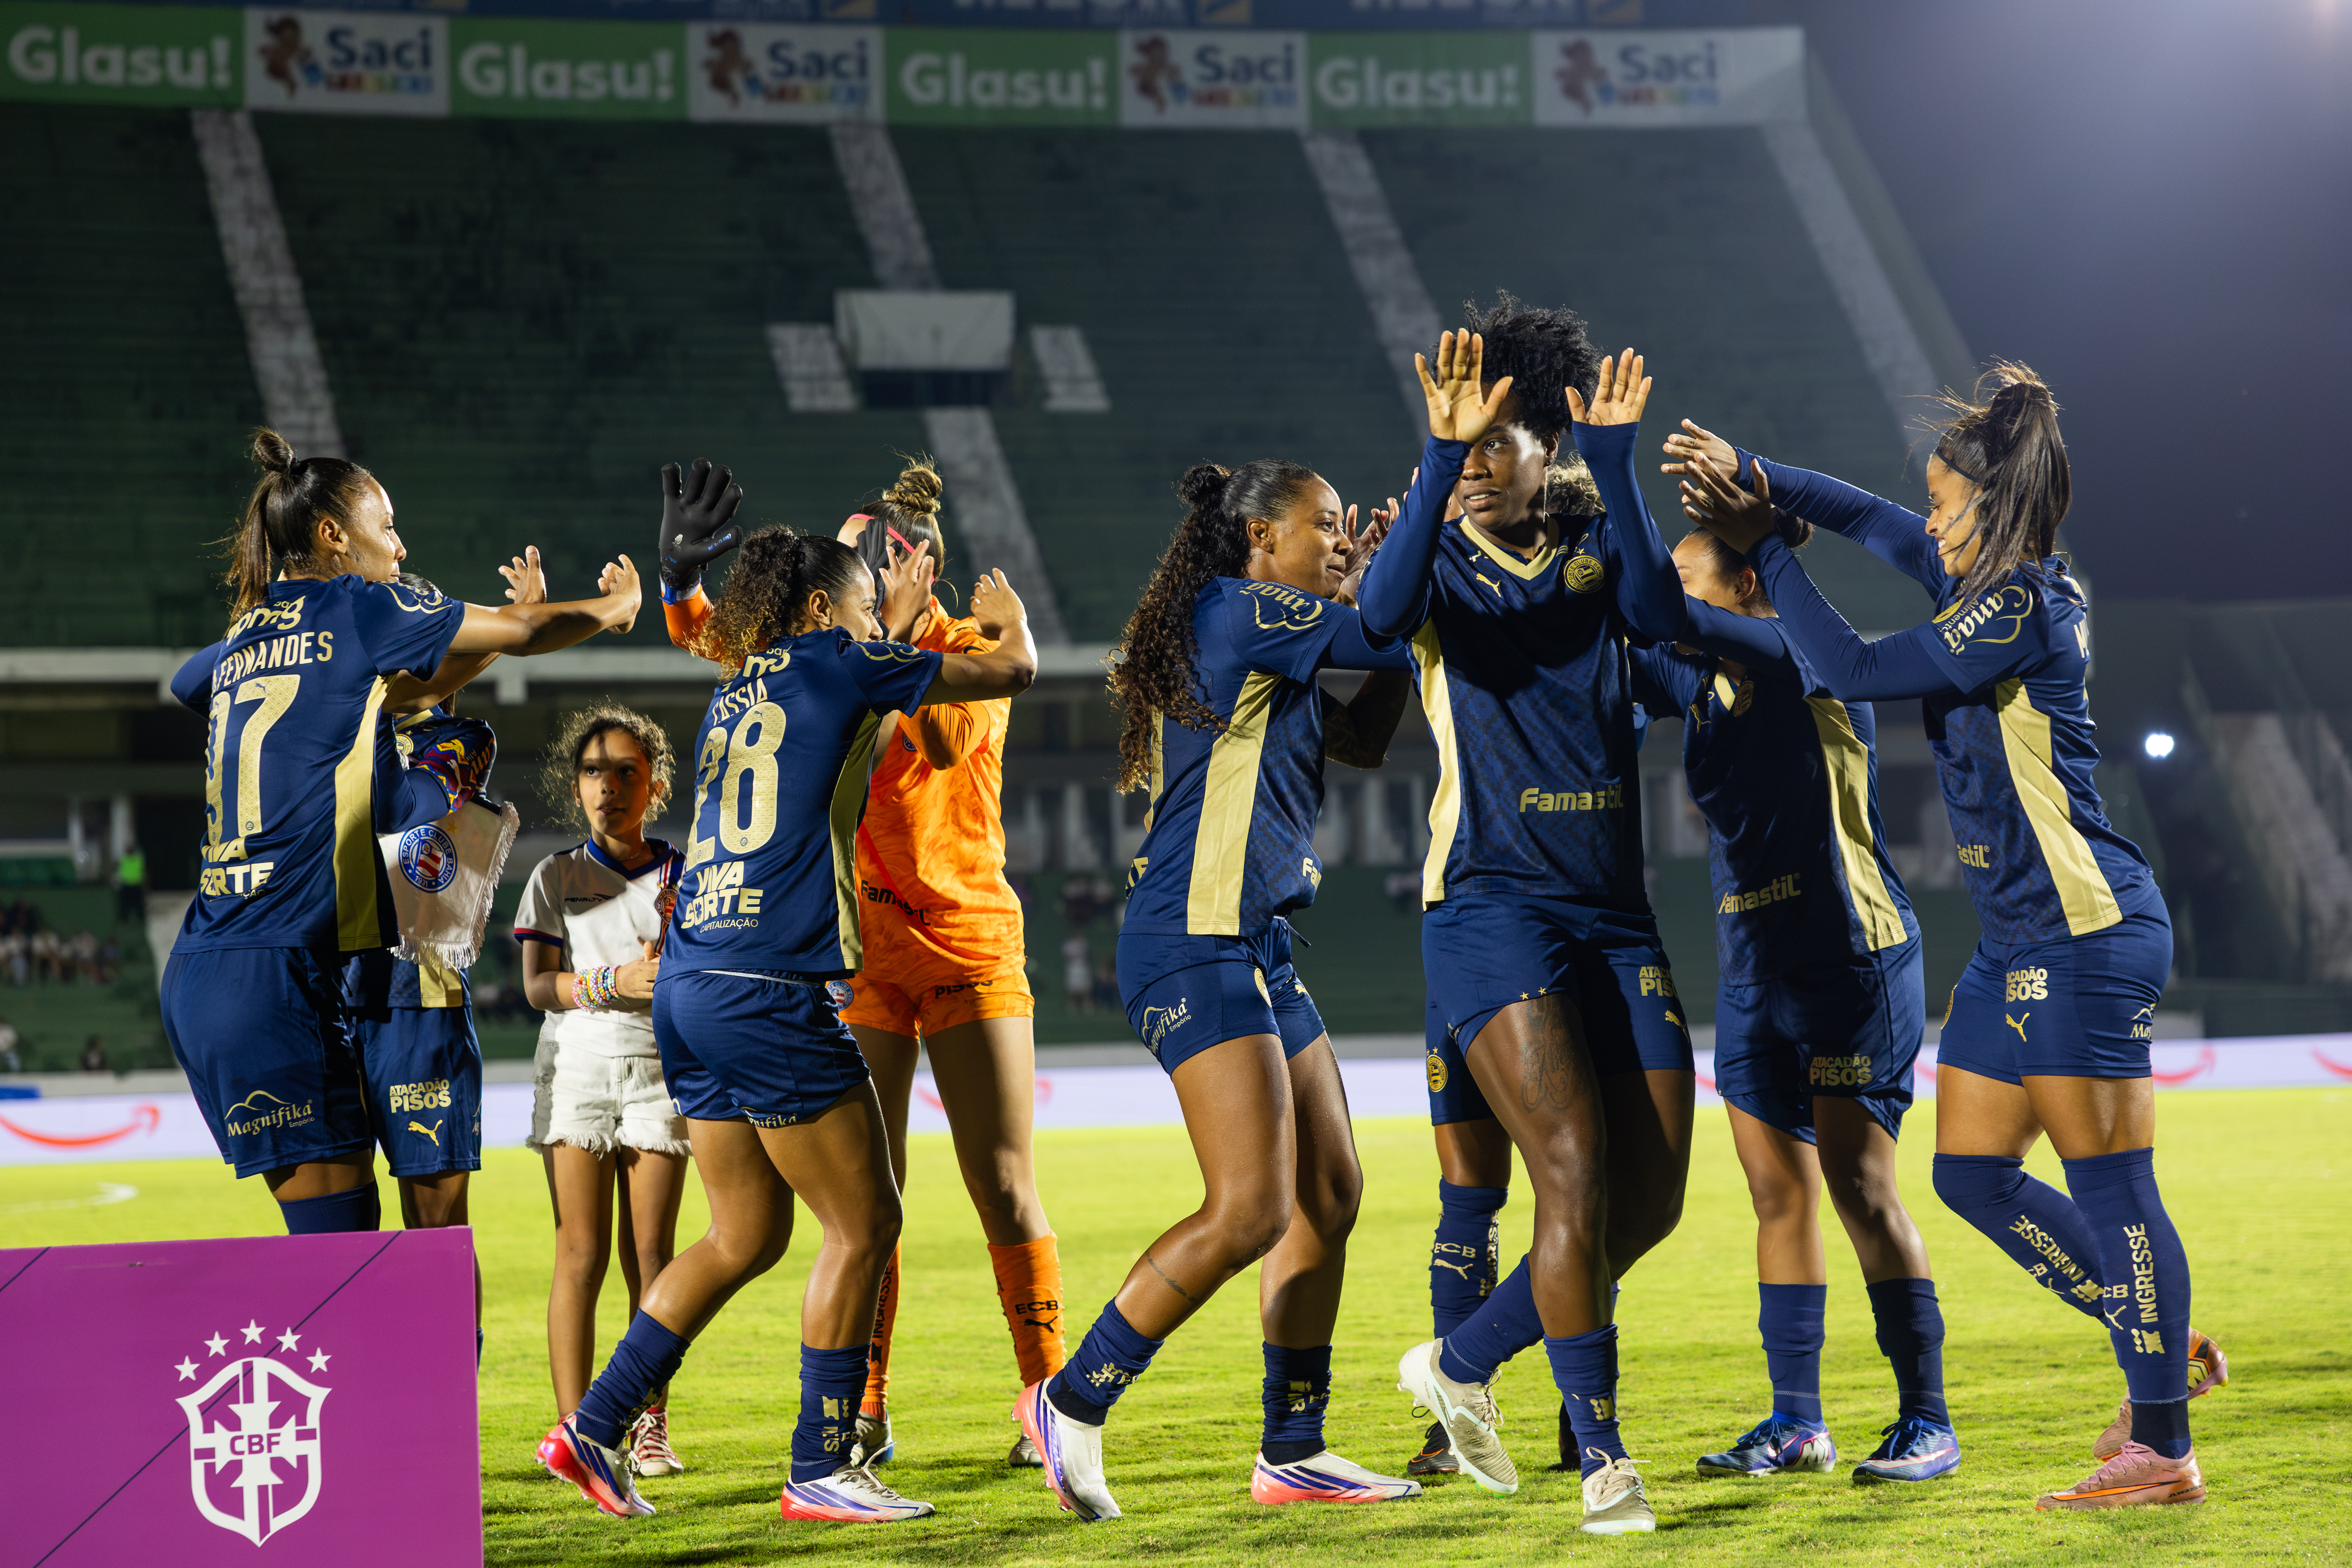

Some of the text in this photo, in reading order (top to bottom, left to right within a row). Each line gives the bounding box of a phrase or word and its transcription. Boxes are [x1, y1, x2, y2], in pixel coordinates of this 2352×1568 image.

[7, 24, 231, 89] Glasu!
[327, 27, 432, 69] Saci
[768, 40, 867, 79] Saci
[1195, 43, 1295, 83] Saci
[1618, 41, 1717, 83] Saci
[458, 41, 675, 102] Glasu!
[899, 50, 1108, 111] Glasu!
[1314, 55, 1522, 108] Glasu!
[1568, 566, 1580, 589] ESPORTE
[685, 702, 786, 871] 28
[1519, 783, 1624, 813] Famastil
[403, 828, 453, 884] ESPORTE CLUBE BAHIA
[415, 876, 428, 887] 1931
[666, 890, 678, 898] CLUB
[695, 861, 744, 897] VIVA
[681, 887, 763, 929] SORTE
[699, 917, 759, 934] CAPITALIZAÇÃO
[2006, 980, 2049, 1003] ISOS
[1169, 1015, 1191, 1032] Empório
[1810, 1053, 1872, 1068] ATACADÃO
[389, 1077, 450, 1097] ATACADÃO
[1809, 1067, 1873, 1086] PISOS
[390, 1090, 451, 1113] PISOS
[228, 1104, 312, 1137] Magnifika
[289, 1117, 315, 1128] Empório
[1434, 1242, 1476, 1259] ECB
[2009, 1215, 2085, 1282] INGRESSE
[2123, 1223, 2159, 1323] INGRESSE
[2102, 1284, 2129, 1298] CB
[1015, 1300, 1058, 1315] ECB
[230, 1432, 281, 1456] CBF
